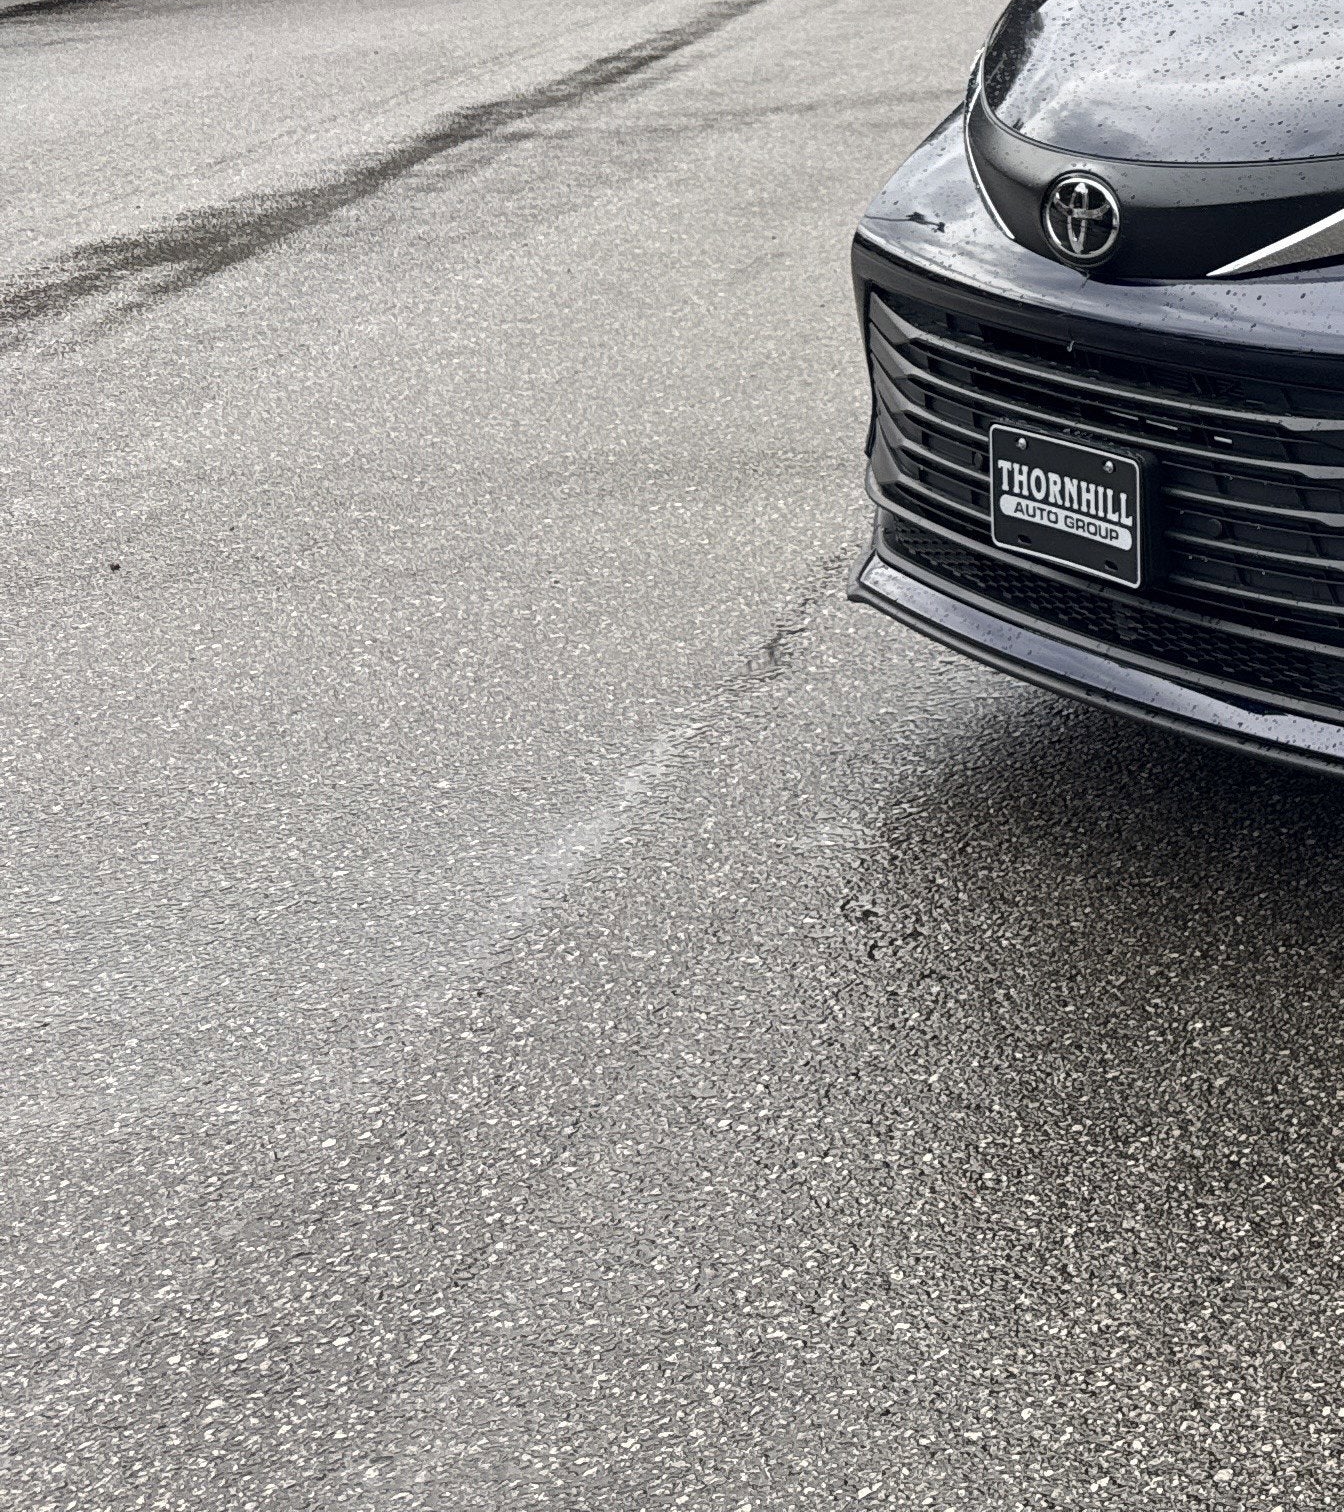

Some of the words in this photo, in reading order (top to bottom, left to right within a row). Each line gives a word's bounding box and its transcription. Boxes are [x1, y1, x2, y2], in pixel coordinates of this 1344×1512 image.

[998, 459, 1133, 527] THORNHILL
[1014, 501, 1059, 525] AUTO
[1064, 514, 1119, 542] GROUP
